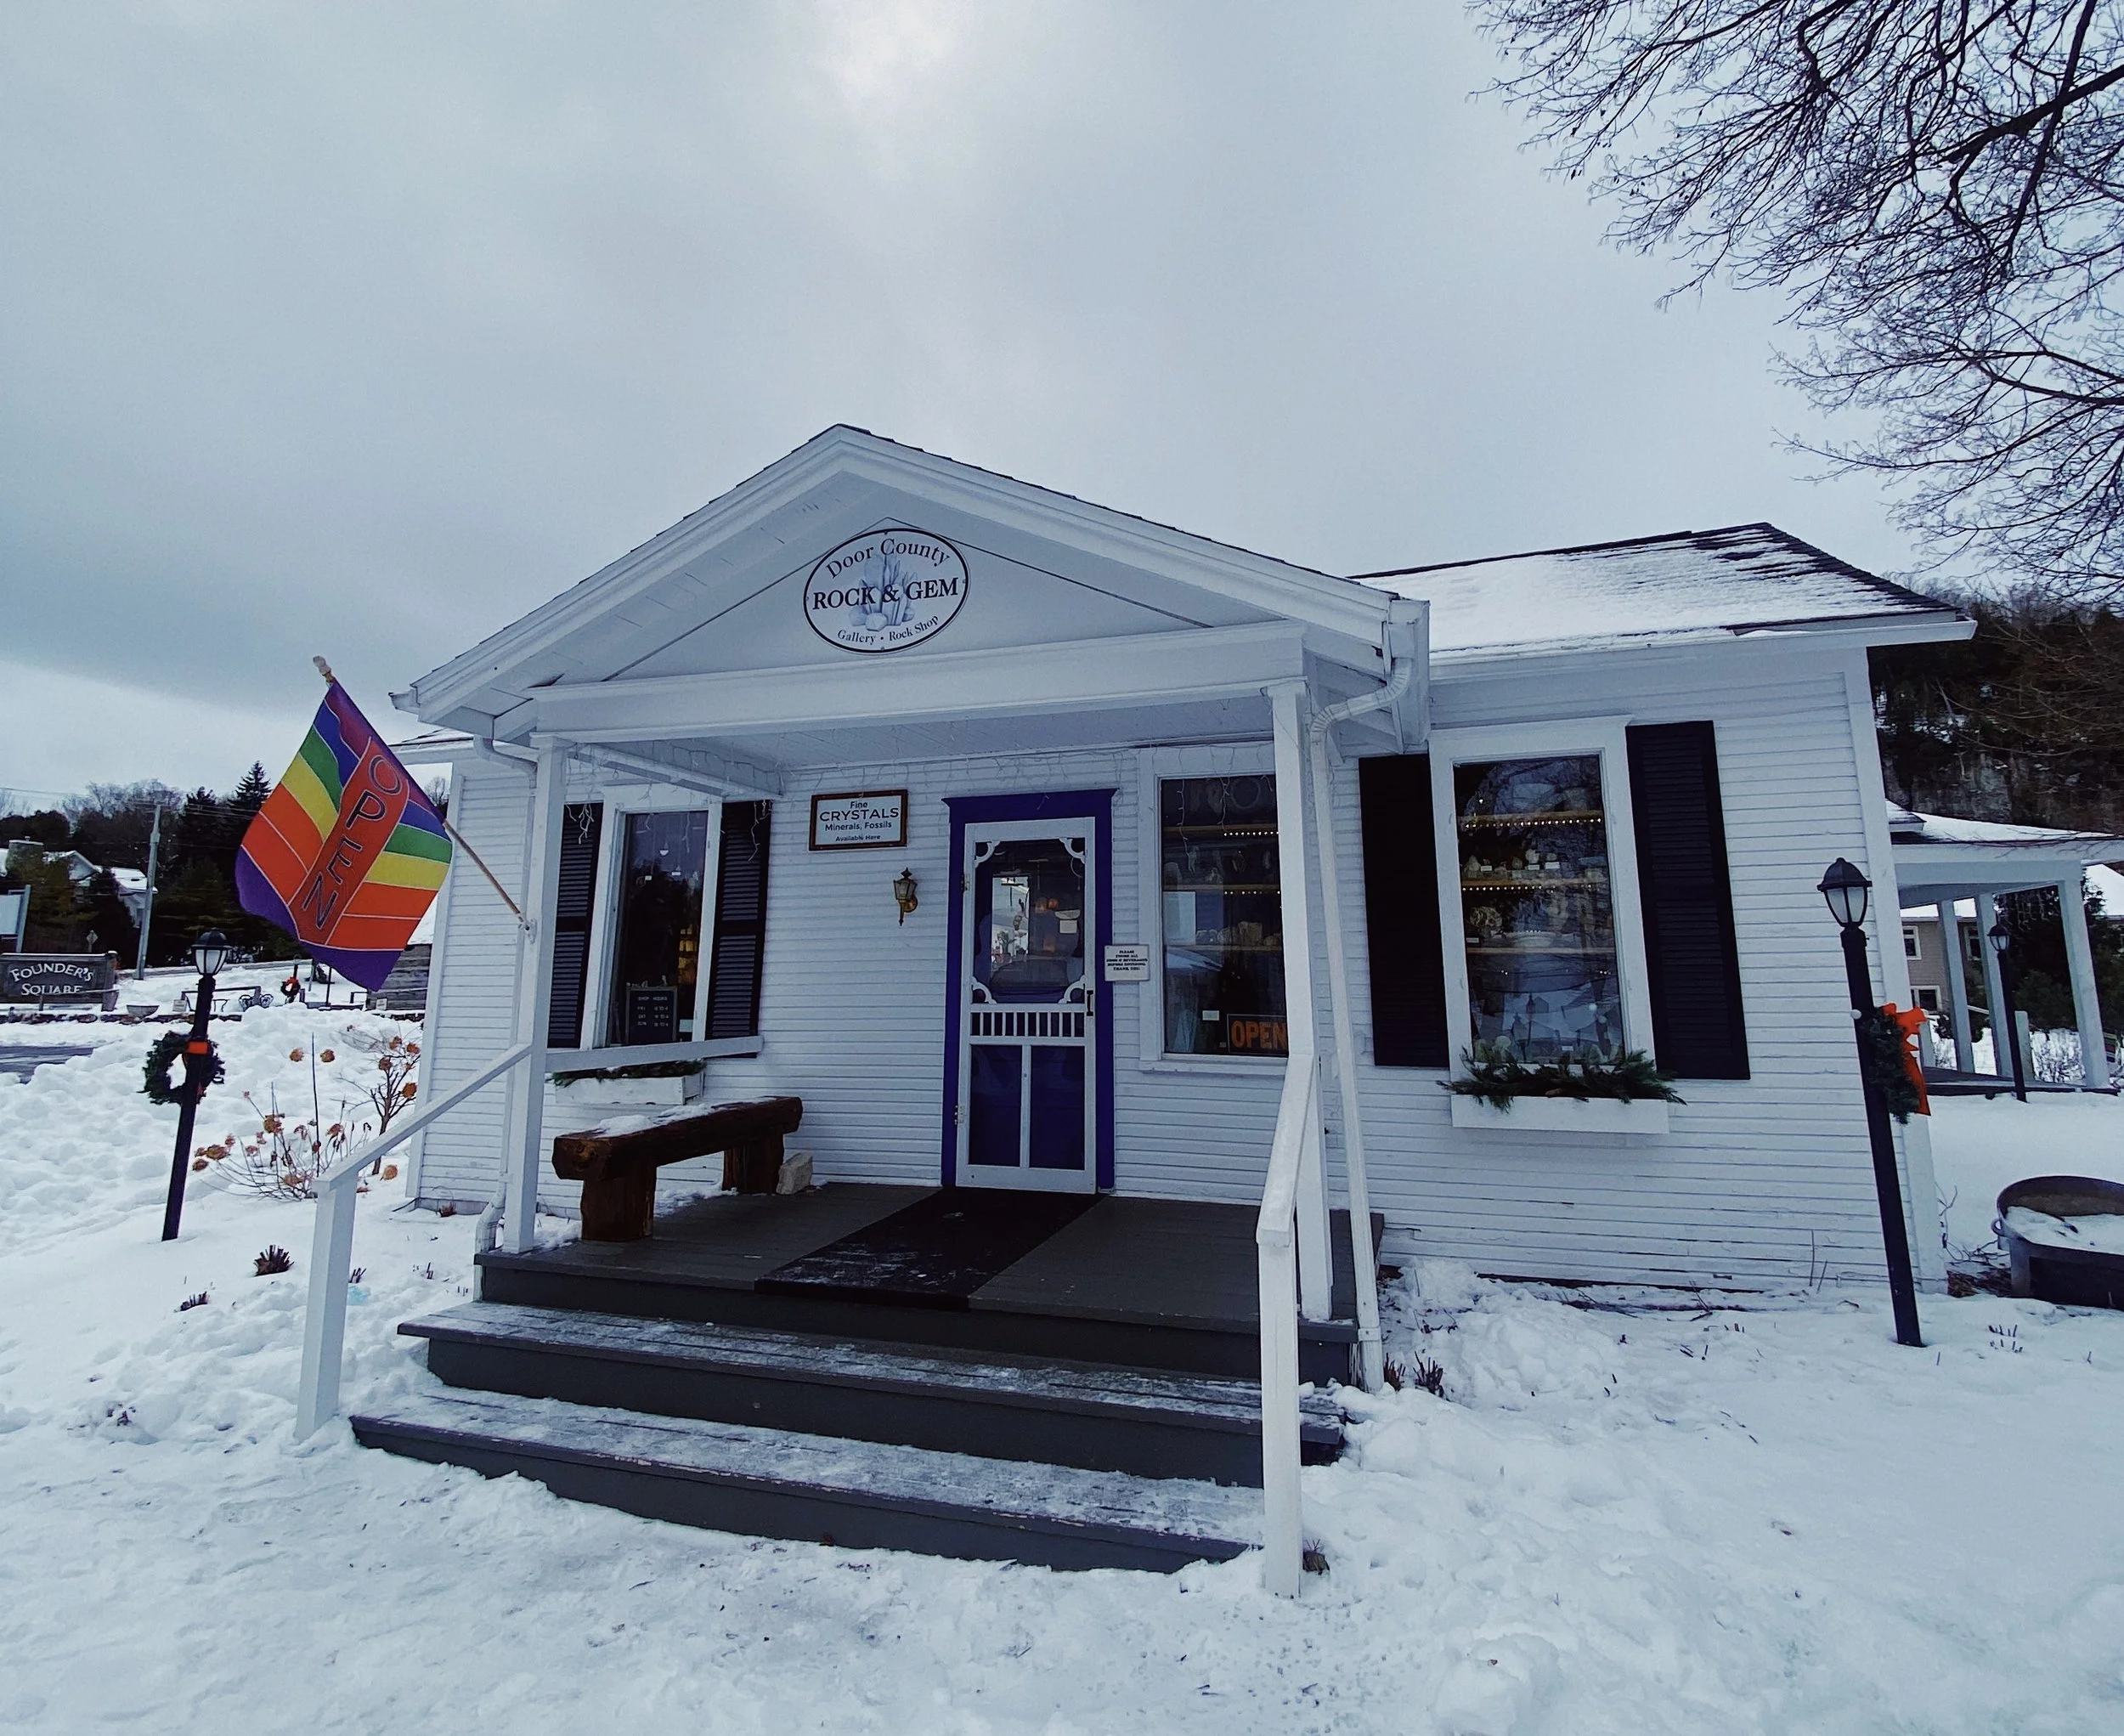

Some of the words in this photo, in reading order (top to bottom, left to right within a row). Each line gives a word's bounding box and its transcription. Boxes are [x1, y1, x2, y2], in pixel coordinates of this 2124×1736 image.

[826, 546, 874, 579] Door
[880, 539, 950, 567] County
[812, 586, 876, 610] ROCK
[881, 584, 901, 603] &
[906, 577, 959, 600] GEM
[838, 630, 876, 645] Gallery
[889, 628, 913, 642] Rock
[915, 615, 939, 634] Shop
[819, 807, 899, 822] CRYSTALS
[824, 823, 862, 832] Minerals,
[302, 755, 403, 930] OPEN
[9, 963, 93, 982] FOUNDER'S
[21, 983, 83, 996] SQUARE
[1231, 1021, 1286, 1050] OPEN
